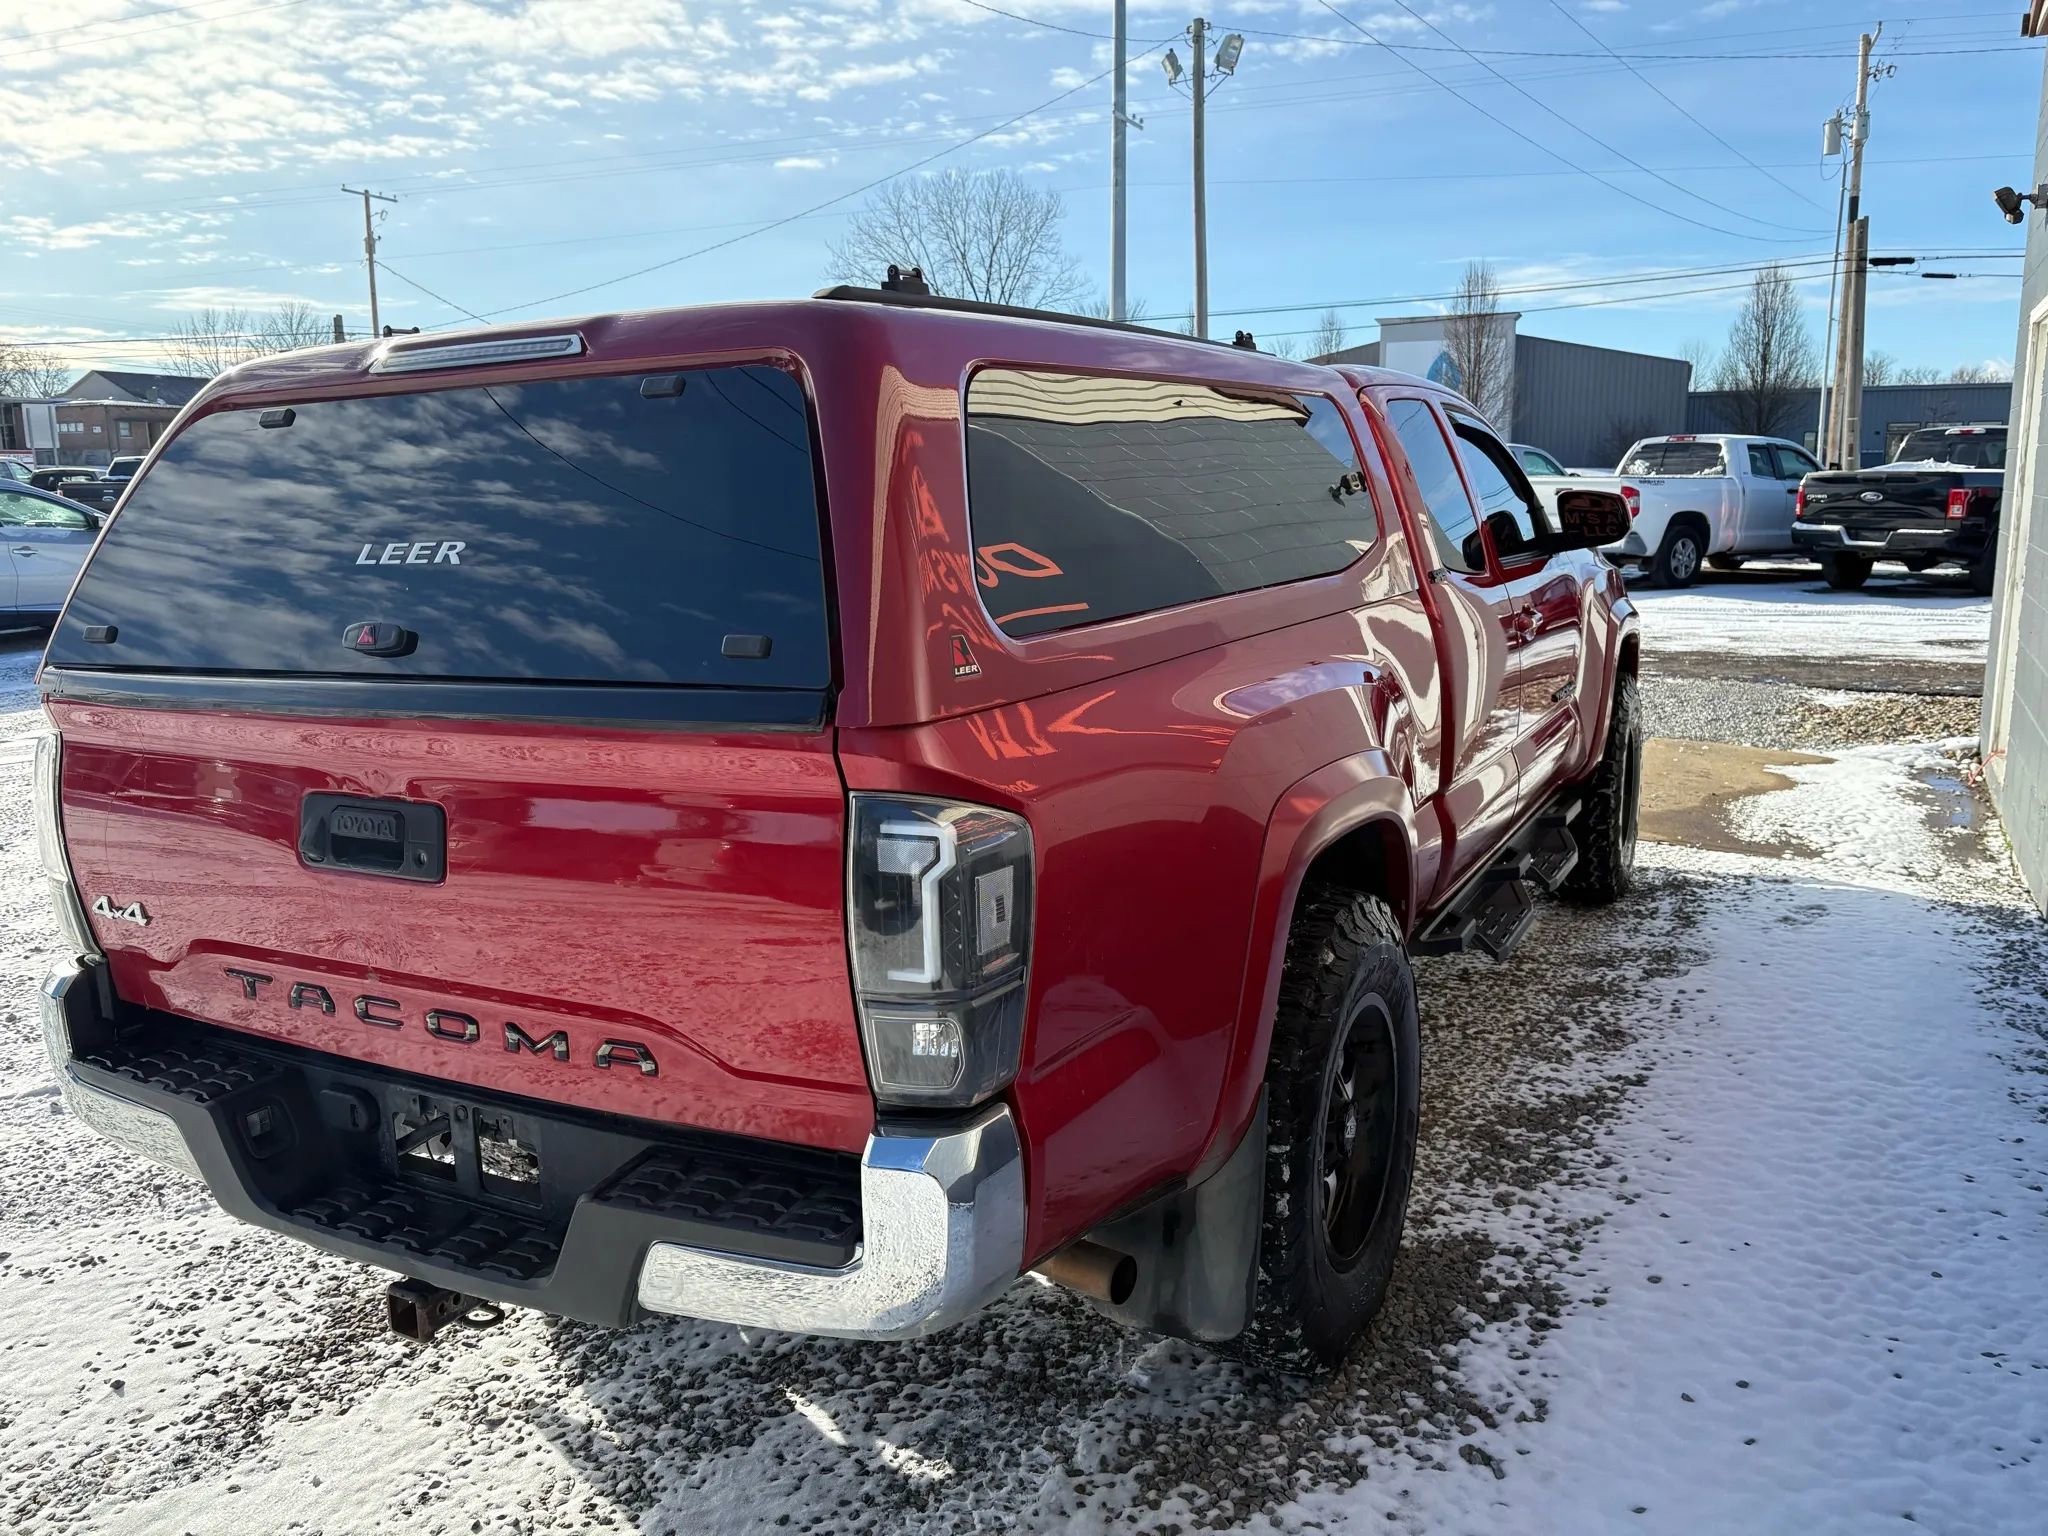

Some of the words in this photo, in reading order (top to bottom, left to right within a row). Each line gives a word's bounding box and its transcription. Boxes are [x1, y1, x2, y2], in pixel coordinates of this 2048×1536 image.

[356, 541, 466, 565] LEER
[954, 664, 979, 676] LEER
[335, 814, 394, 838] TOYOTA
[91, 895, 148, 927] 4x4
[224, 966, 661, 1078] TACOMA
